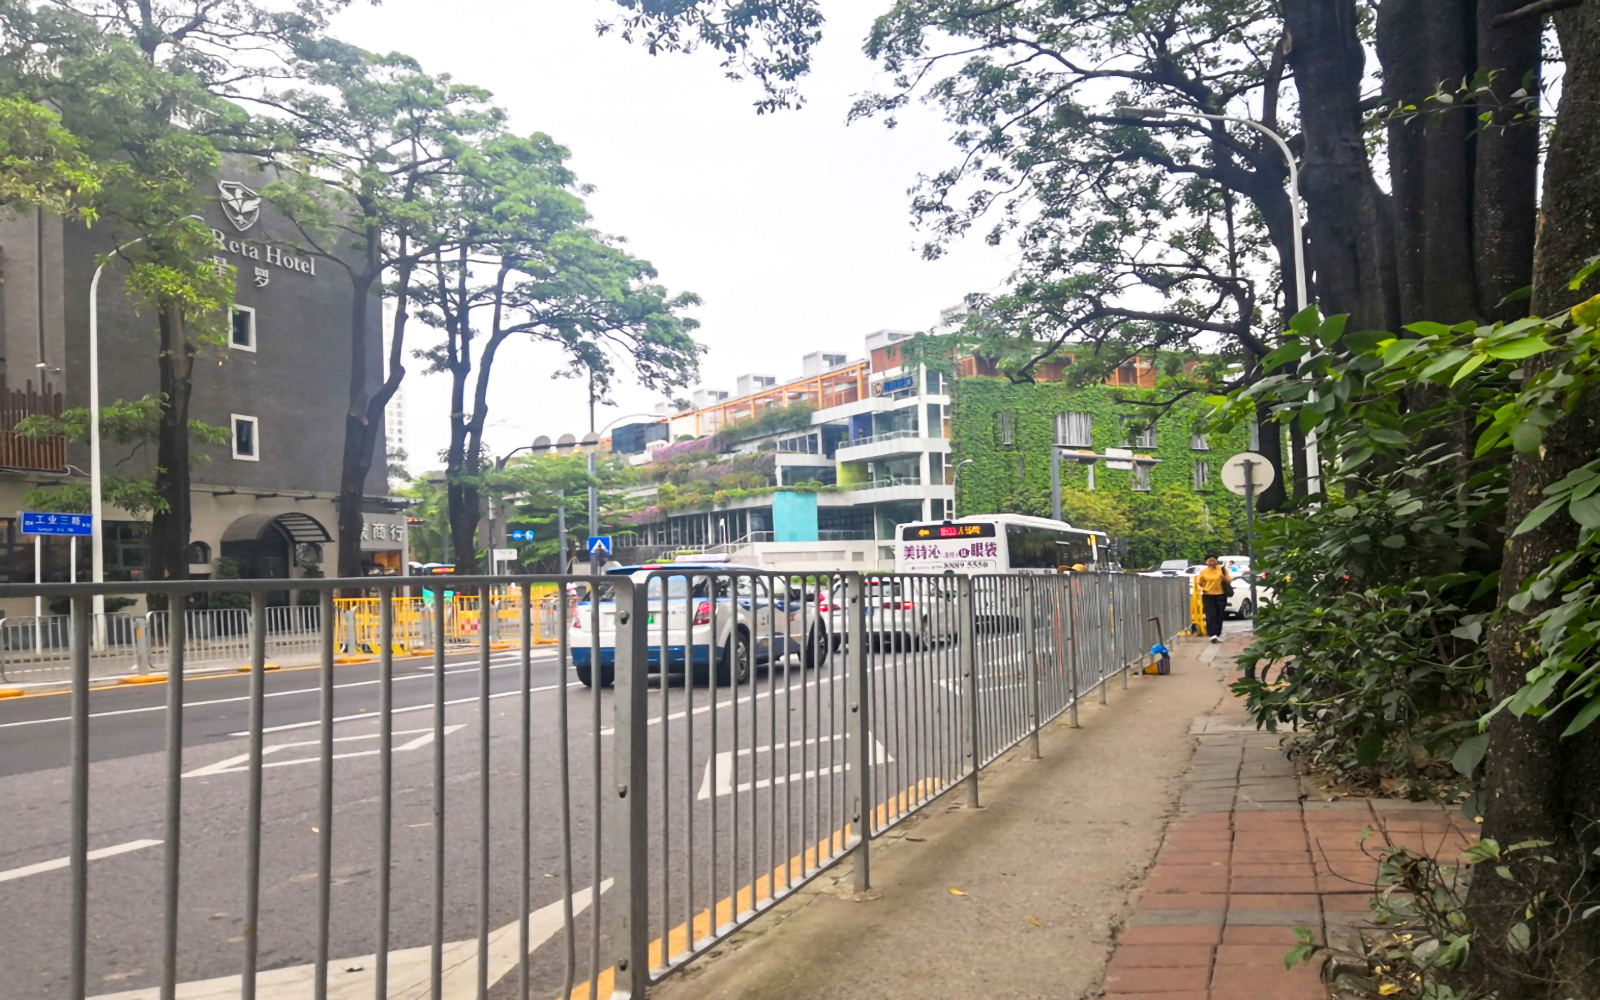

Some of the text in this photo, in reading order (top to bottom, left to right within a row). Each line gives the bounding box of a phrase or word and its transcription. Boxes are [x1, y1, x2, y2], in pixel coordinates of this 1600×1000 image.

[209, 228, 316, 276] Reta Hotel
[903, 545, 940, 560] 美诗沁
